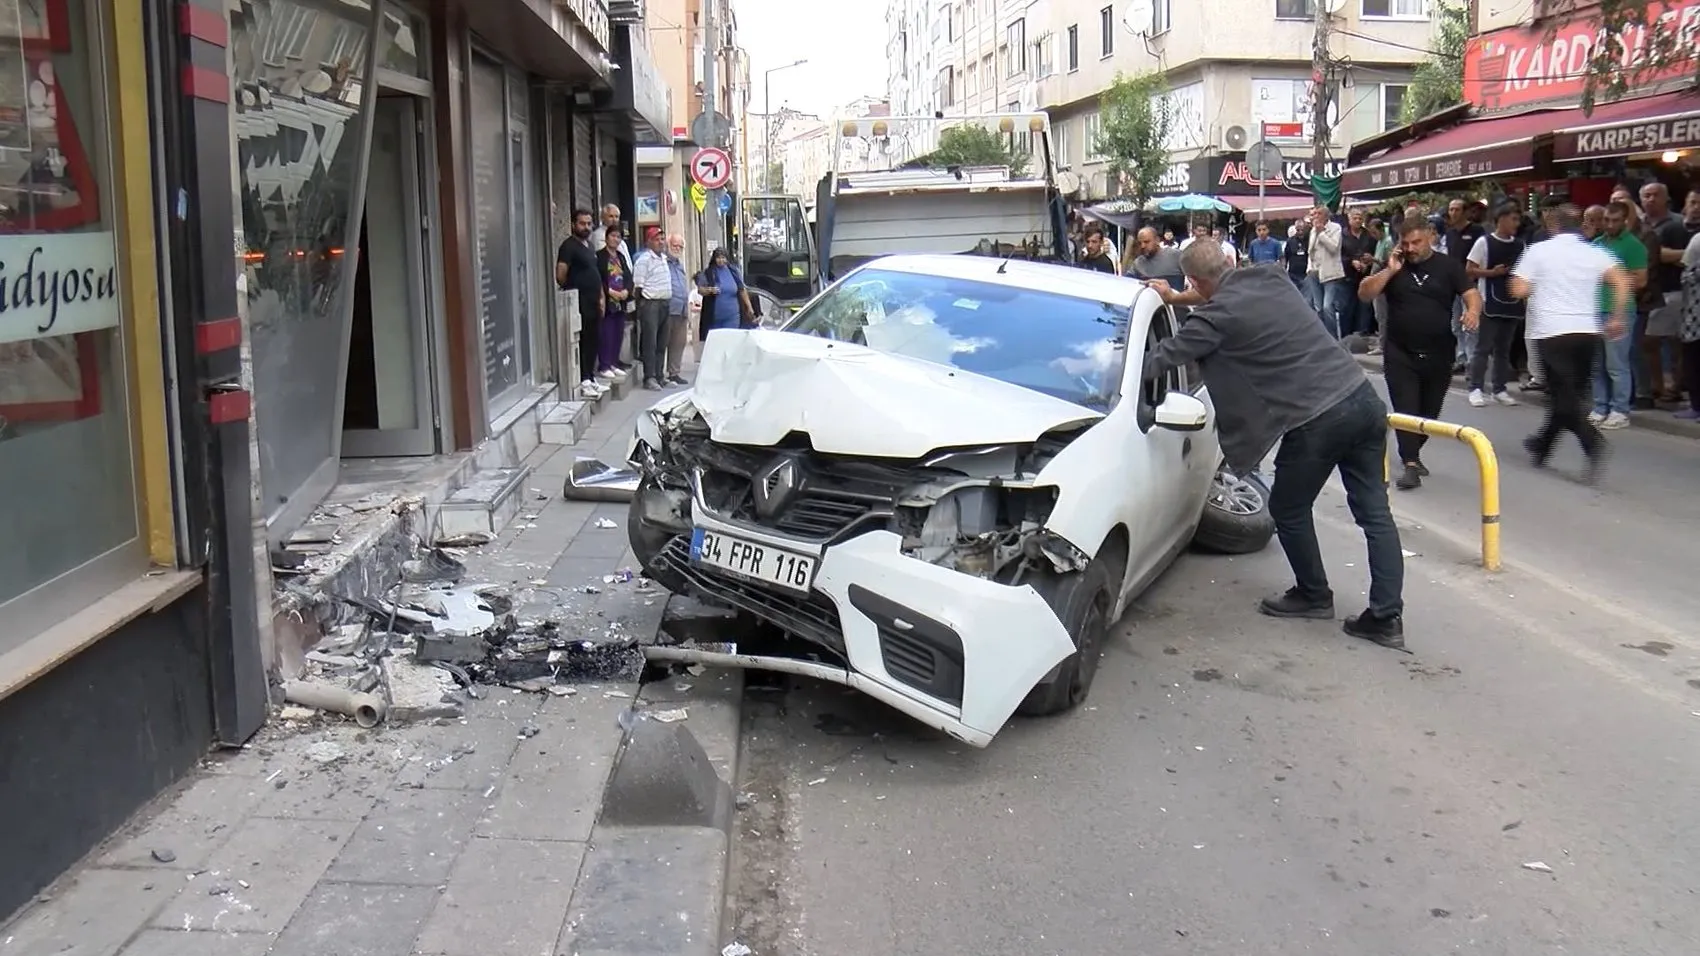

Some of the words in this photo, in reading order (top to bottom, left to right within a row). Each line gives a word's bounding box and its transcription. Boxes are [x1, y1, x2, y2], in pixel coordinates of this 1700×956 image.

[702, 535, 721, 562] 34
[729, 541, 764, 574] FPR
[775, 554, 809, 587] 116
